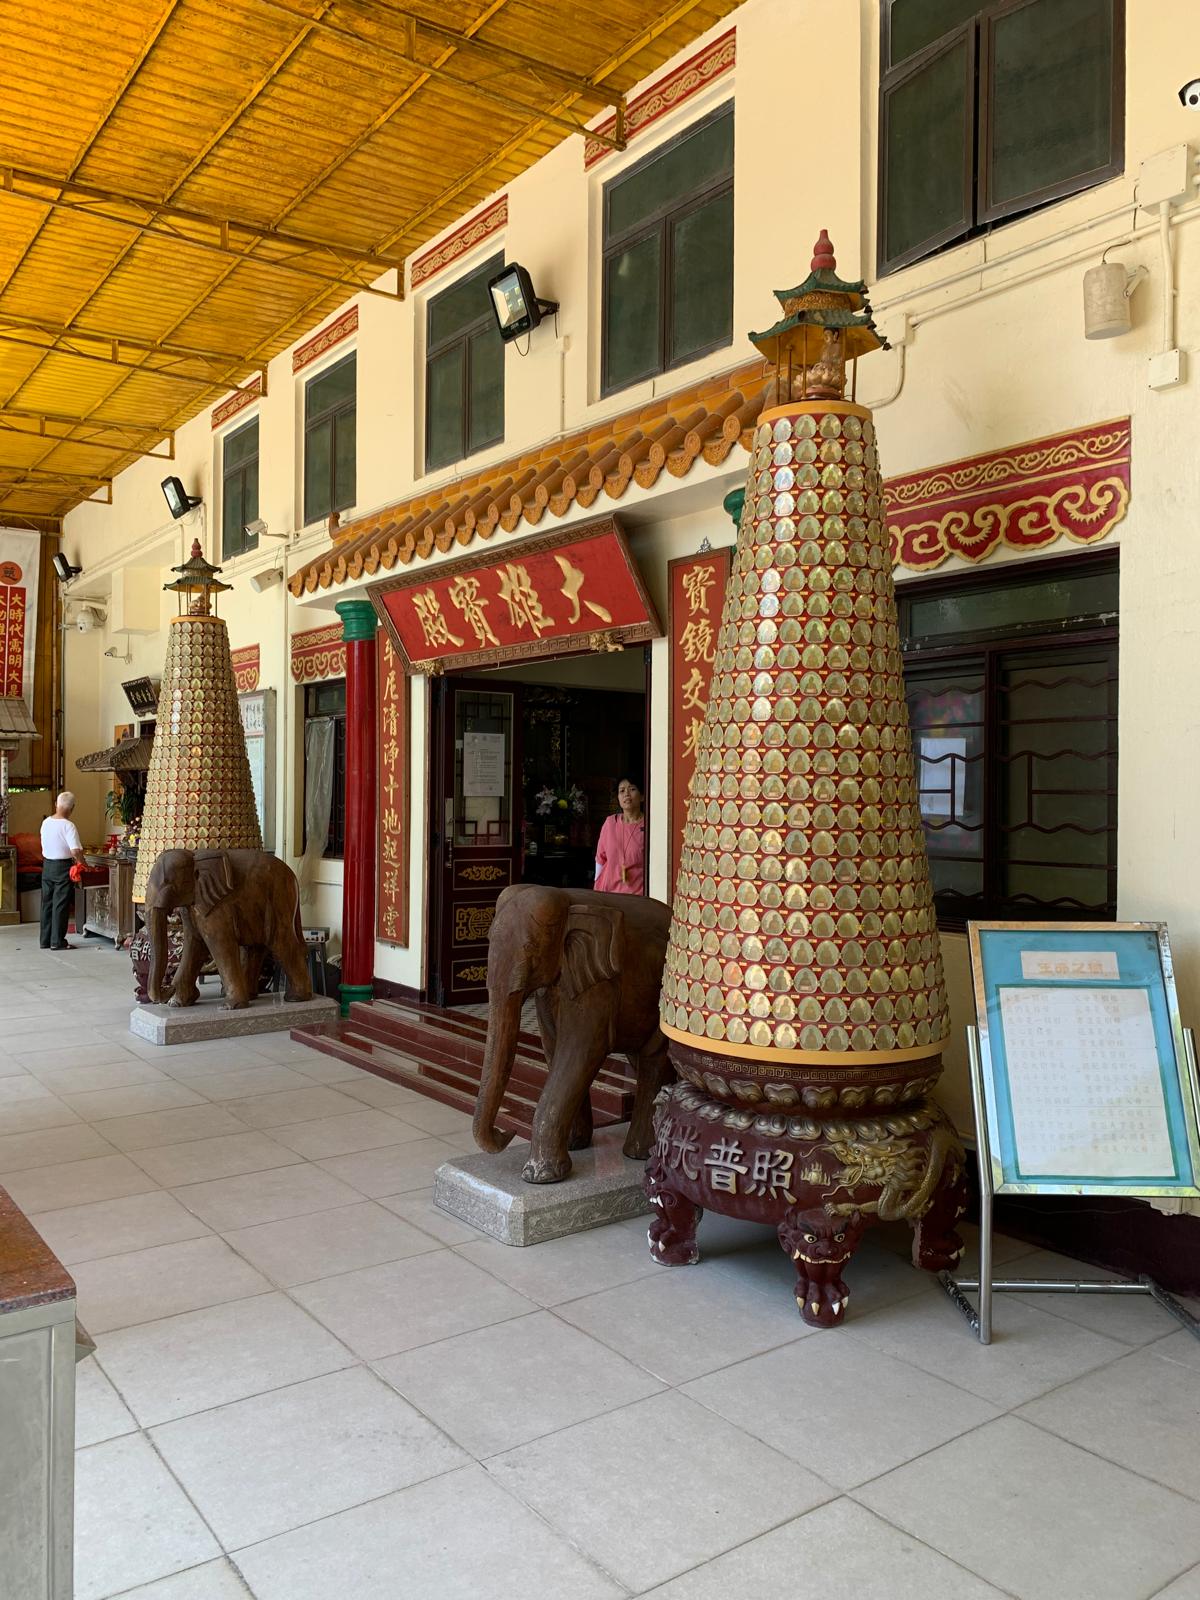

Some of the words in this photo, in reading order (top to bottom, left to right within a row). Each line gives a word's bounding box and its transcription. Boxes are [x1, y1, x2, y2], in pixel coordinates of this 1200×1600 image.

[411, 555, 613, 649] 大雄寶殿
[657, 1115, 798, 1205] 佛光普照
